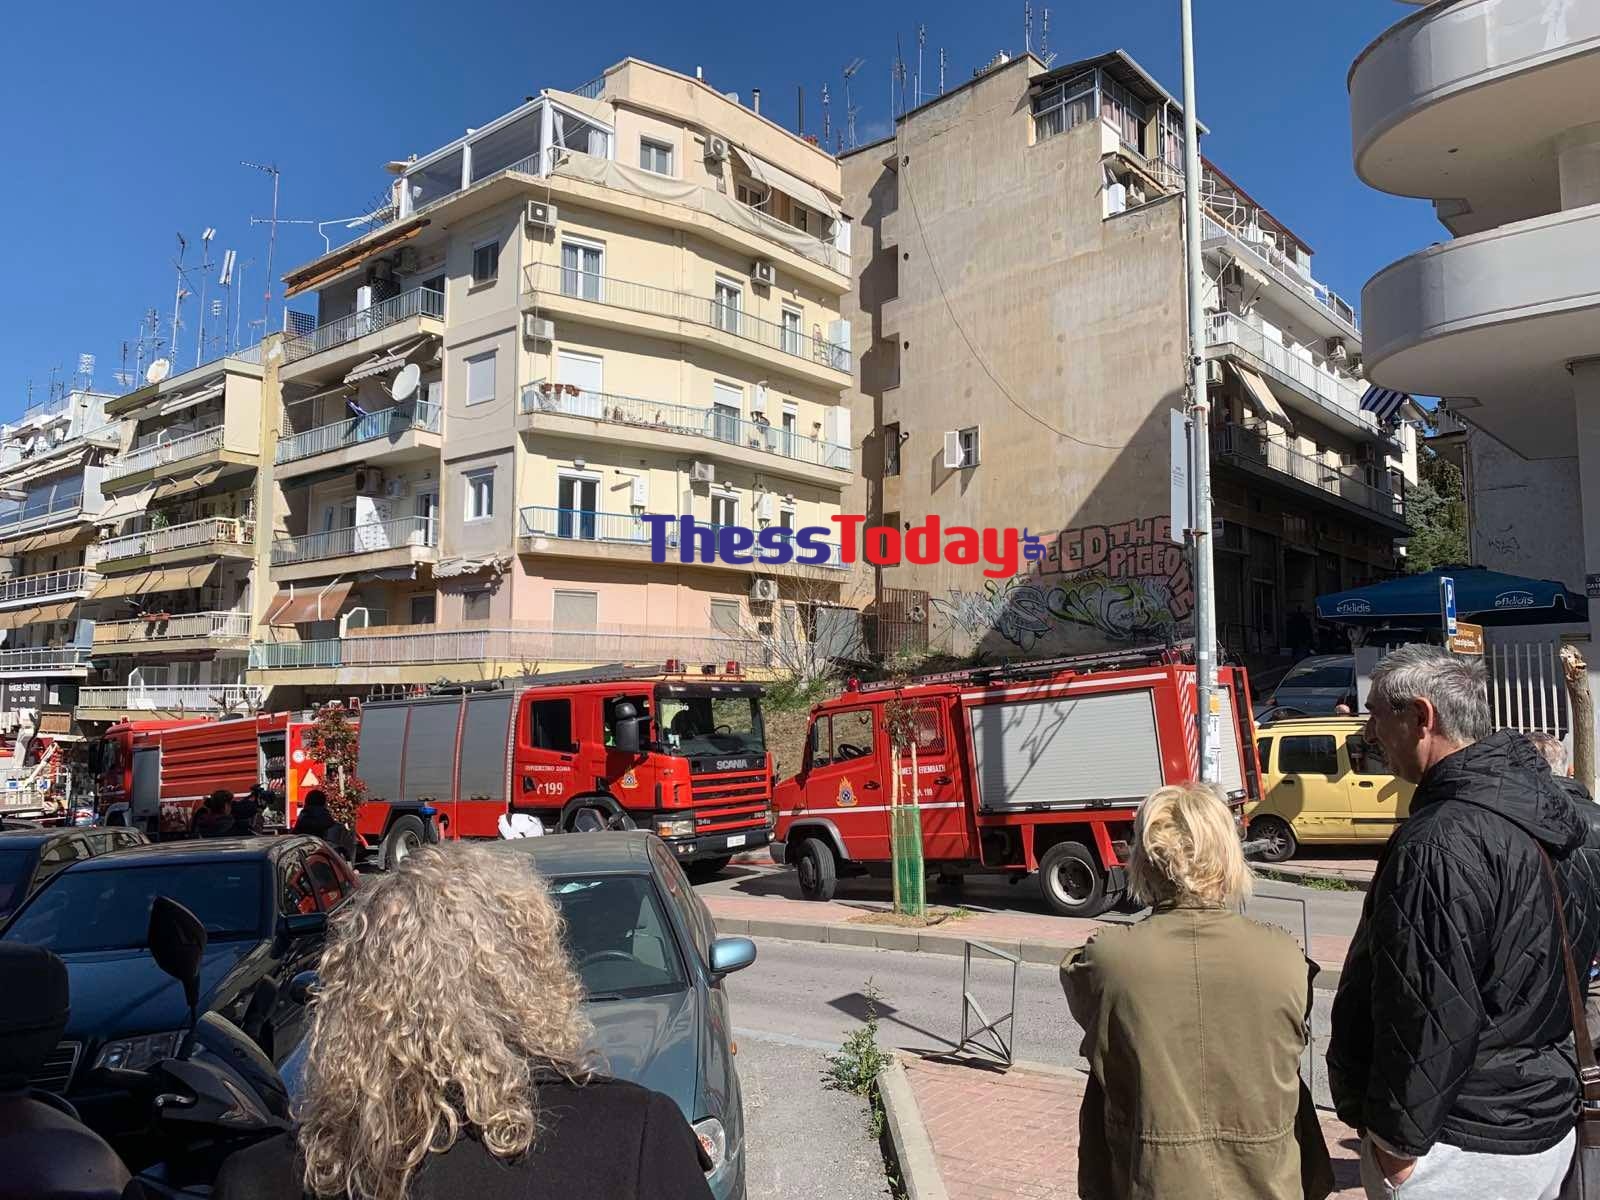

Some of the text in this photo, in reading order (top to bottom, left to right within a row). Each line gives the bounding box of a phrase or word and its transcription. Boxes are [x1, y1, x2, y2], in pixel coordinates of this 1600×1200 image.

[1108, 515, 1172, 547] THE
[716, 760, 748, 770] SCANIA
[543, 782, 563, 795] 199
